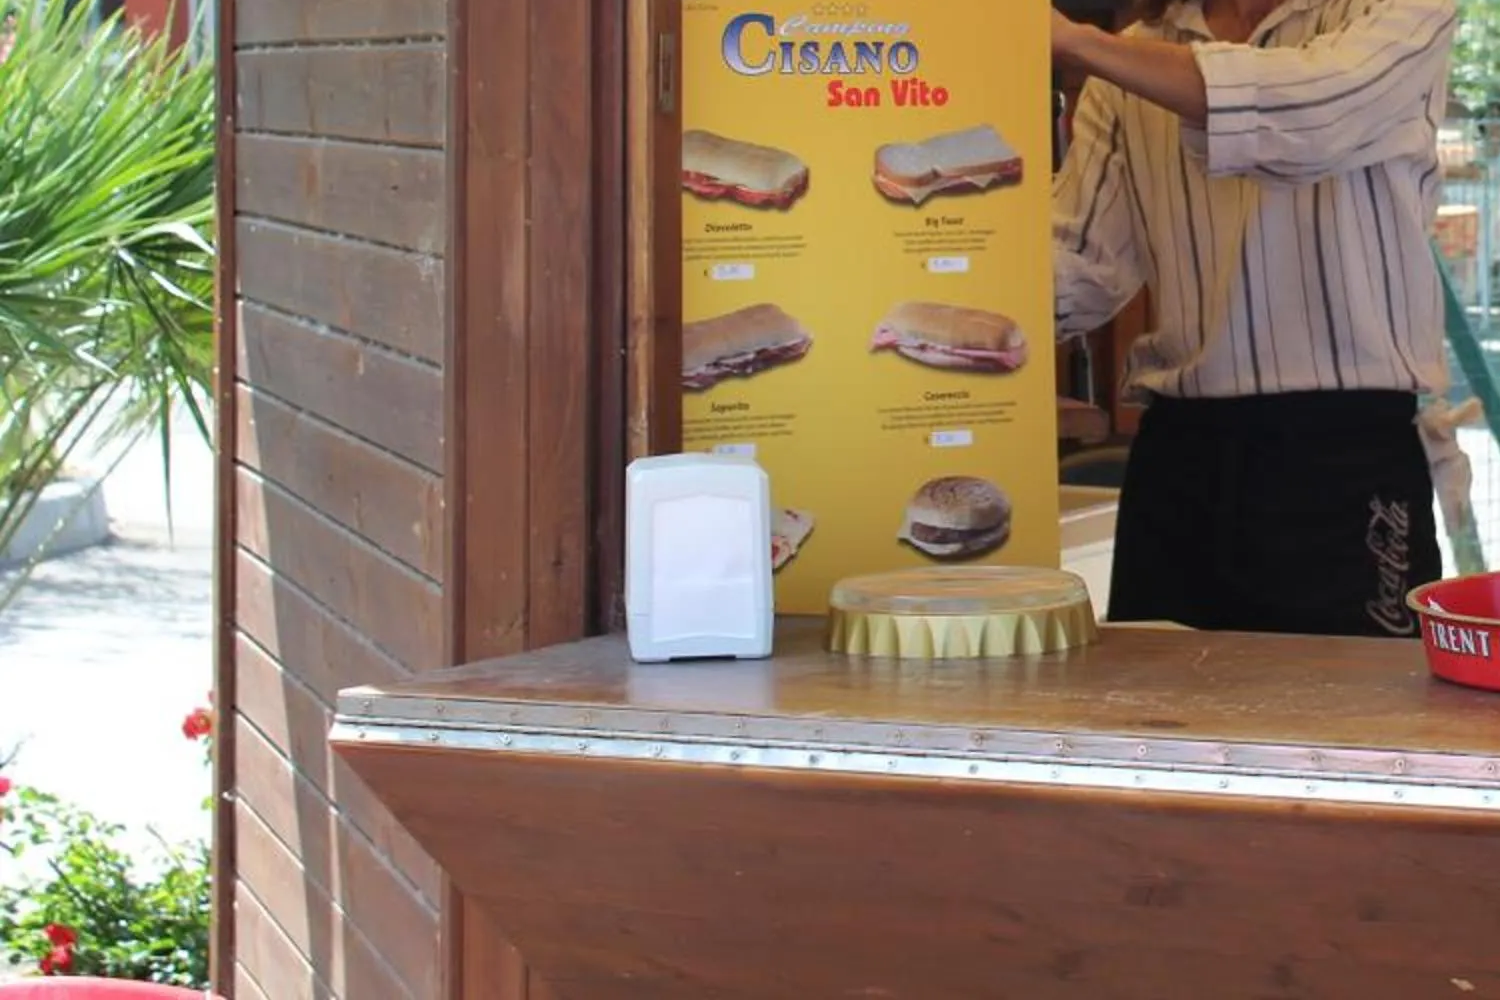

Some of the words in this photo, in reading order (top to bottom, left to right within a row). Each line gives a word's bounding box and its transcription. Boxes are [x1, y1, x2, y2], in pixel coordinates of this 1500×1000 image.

[721, 12, 920, 77] CISANO
[827, 79, 881, 108] San
[890, 77, 949, 108] Vito
[1429, 622, 1490, 657] TRENT
